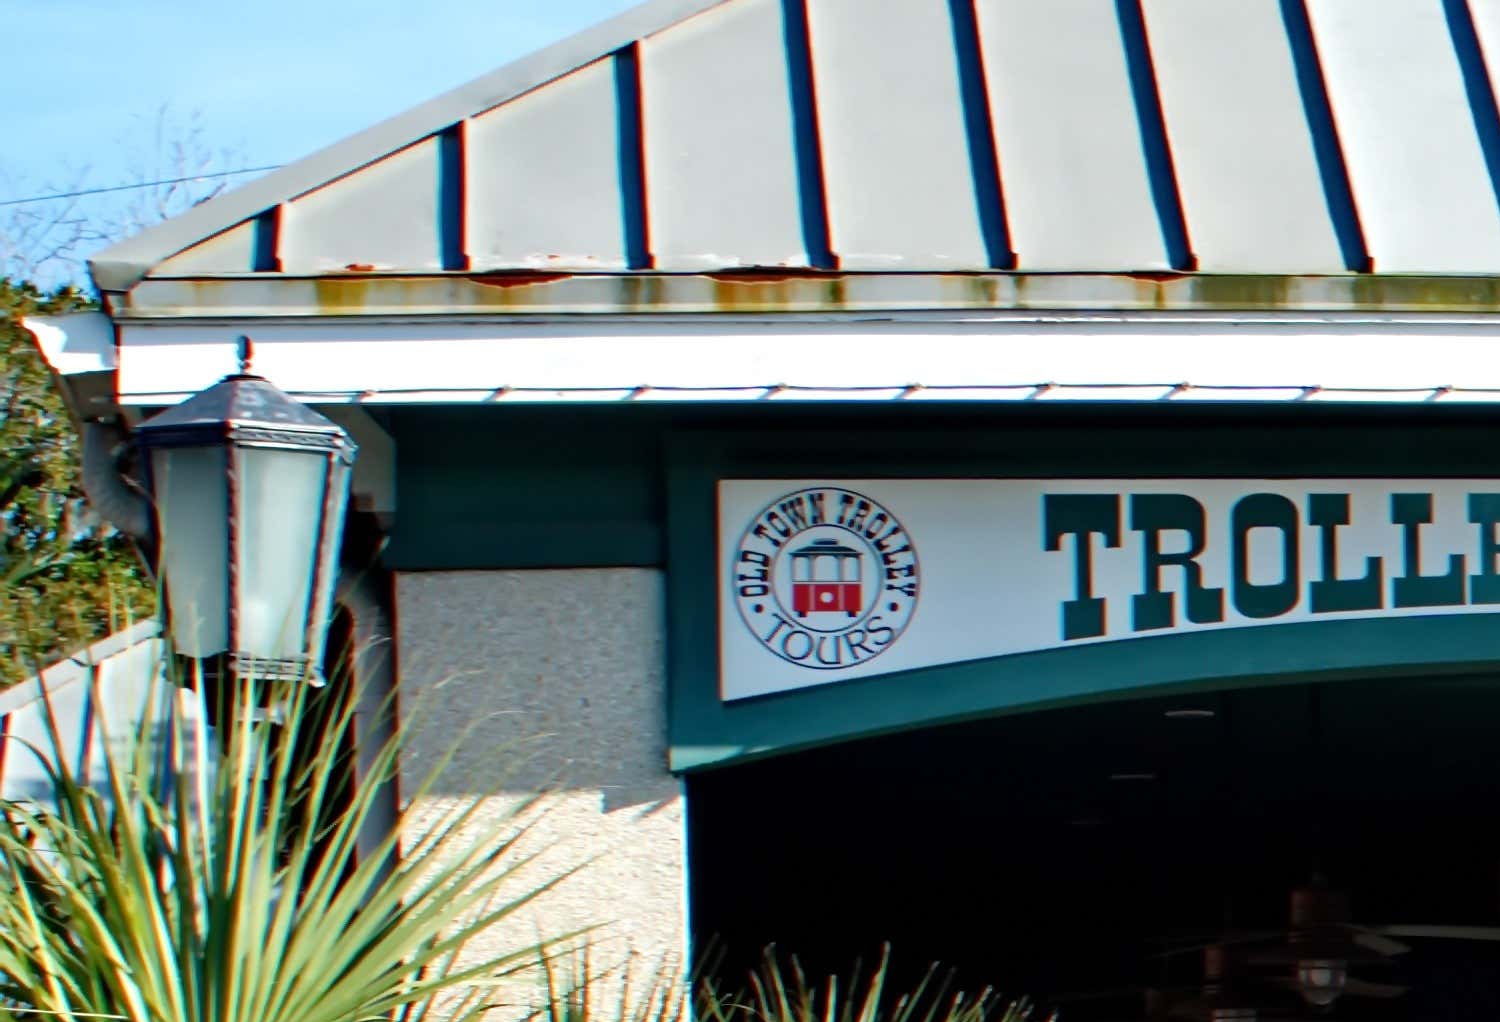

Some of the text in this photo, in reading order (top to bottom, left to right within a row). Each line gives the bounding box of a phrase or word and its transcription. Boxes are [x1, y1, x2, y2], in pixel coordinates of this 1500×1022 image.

[739, 493, 916, 597] OLD TOWN TROLLEY
[764, 613, 896, 665] TOURS
